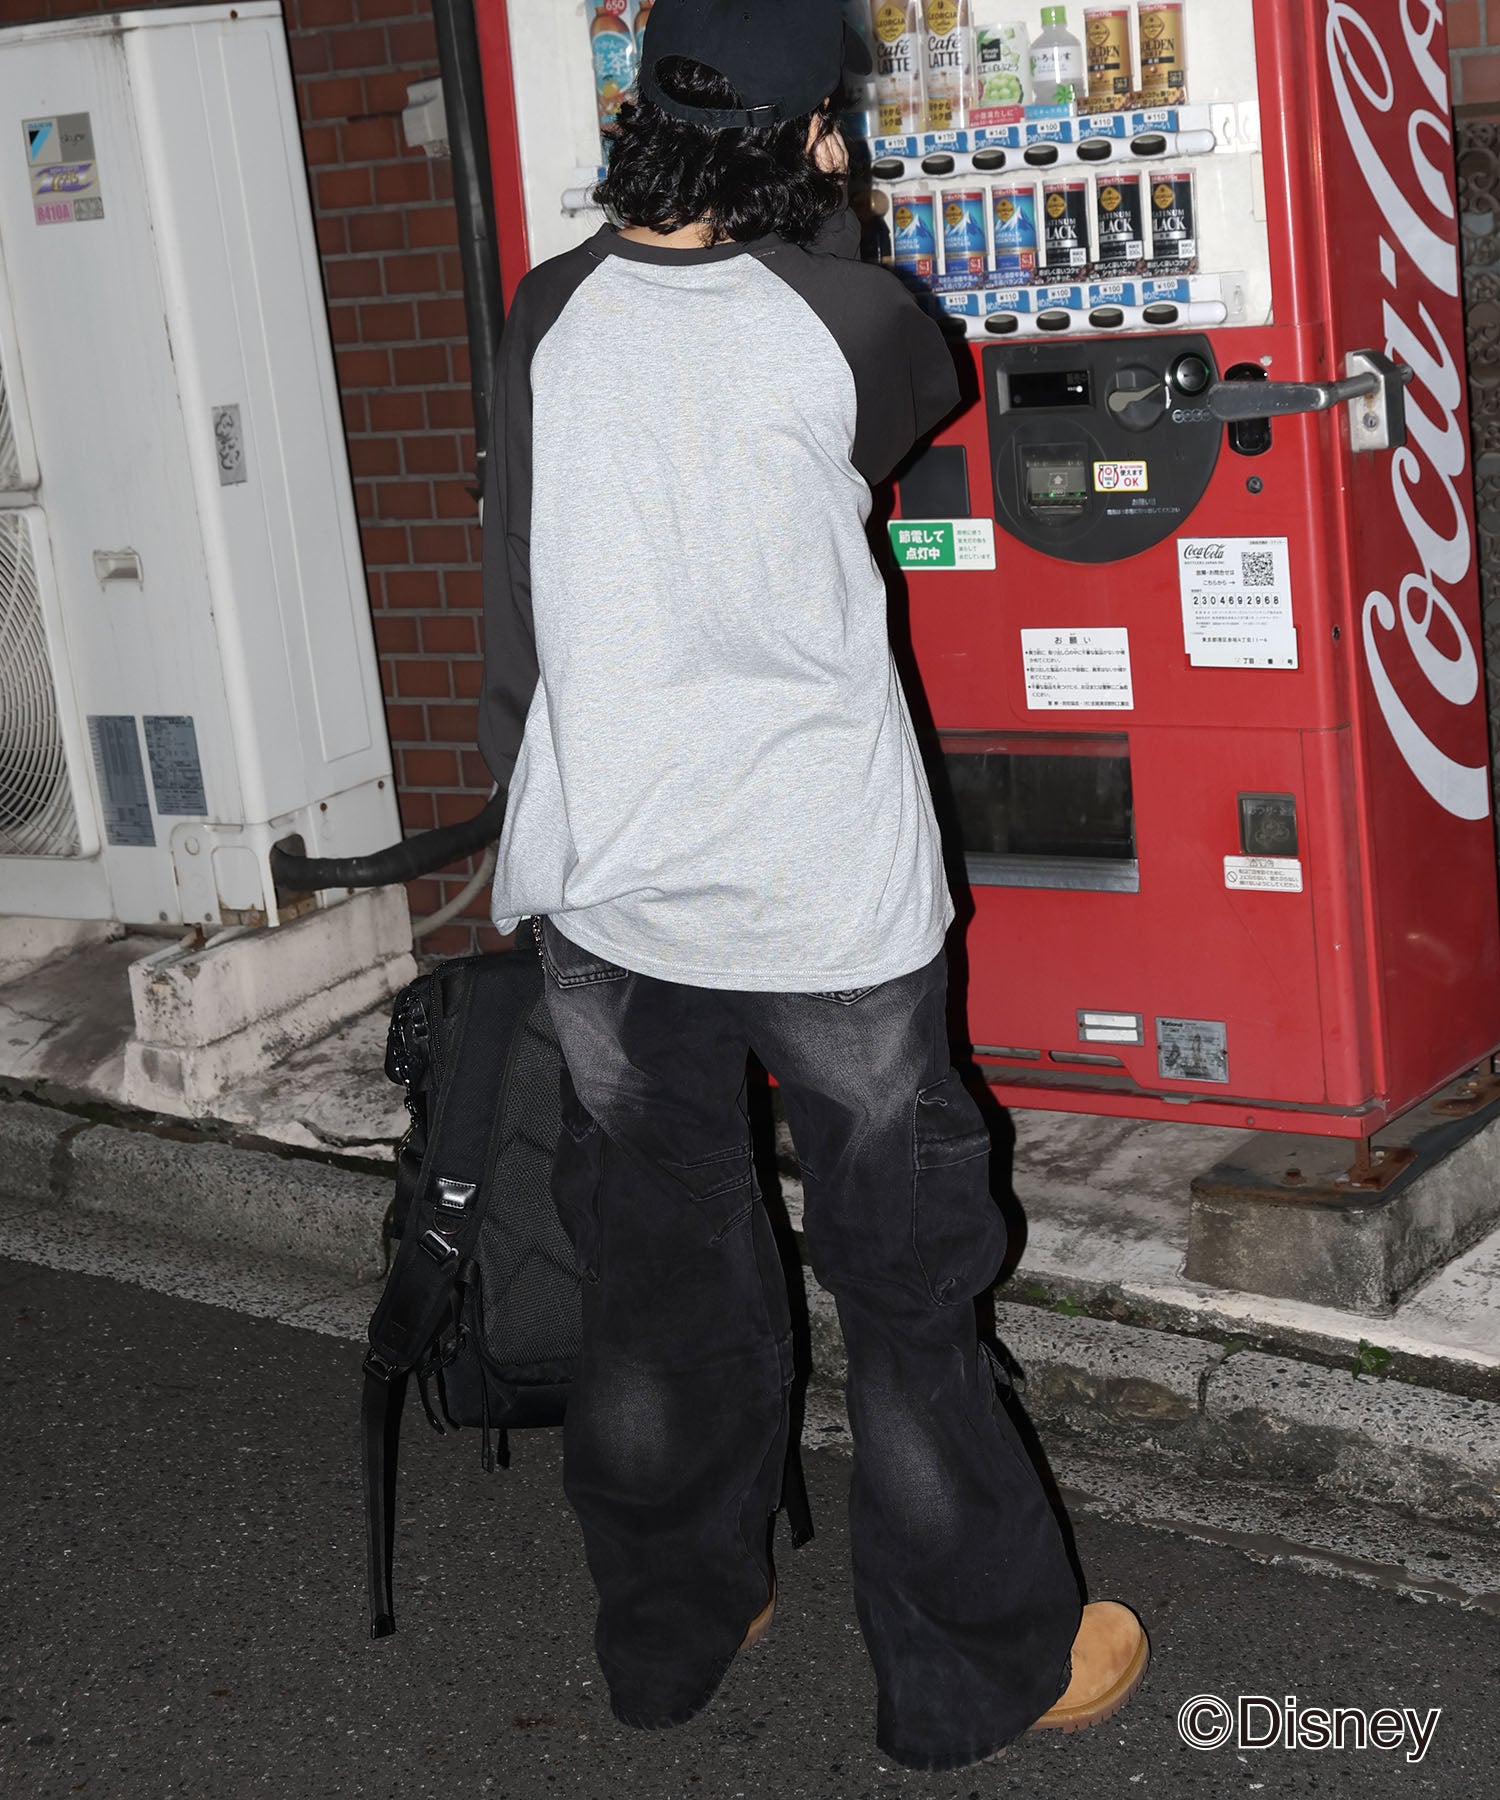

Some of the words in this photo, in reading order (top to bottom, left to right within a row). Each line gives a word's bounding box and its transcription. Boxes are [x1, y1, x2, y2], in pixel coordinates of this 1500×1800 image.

[928, 33, 962, 51] Café
[877, 39, 910, 57] Café
[929, 51, 962, 69] LATTE
[878, 57, 911, 75] LATTE
[1094, 118, 1111, 126] ¥110
[1147, 113, 1165, 121] ¥110
[37, 203, 71, 220] R410A
[1103, 285, 1120, 293] ¥100
[1157, 281, 1175, 289] ¥100
[1000, 292, 1016, 300] ¥110
[1051, 289, 1068, 297] ¥100
[1124, 477, 1139, 487] OK
[898, 530, 944, 543] 節電して
[906, 547, 940, 560] 点灯中
